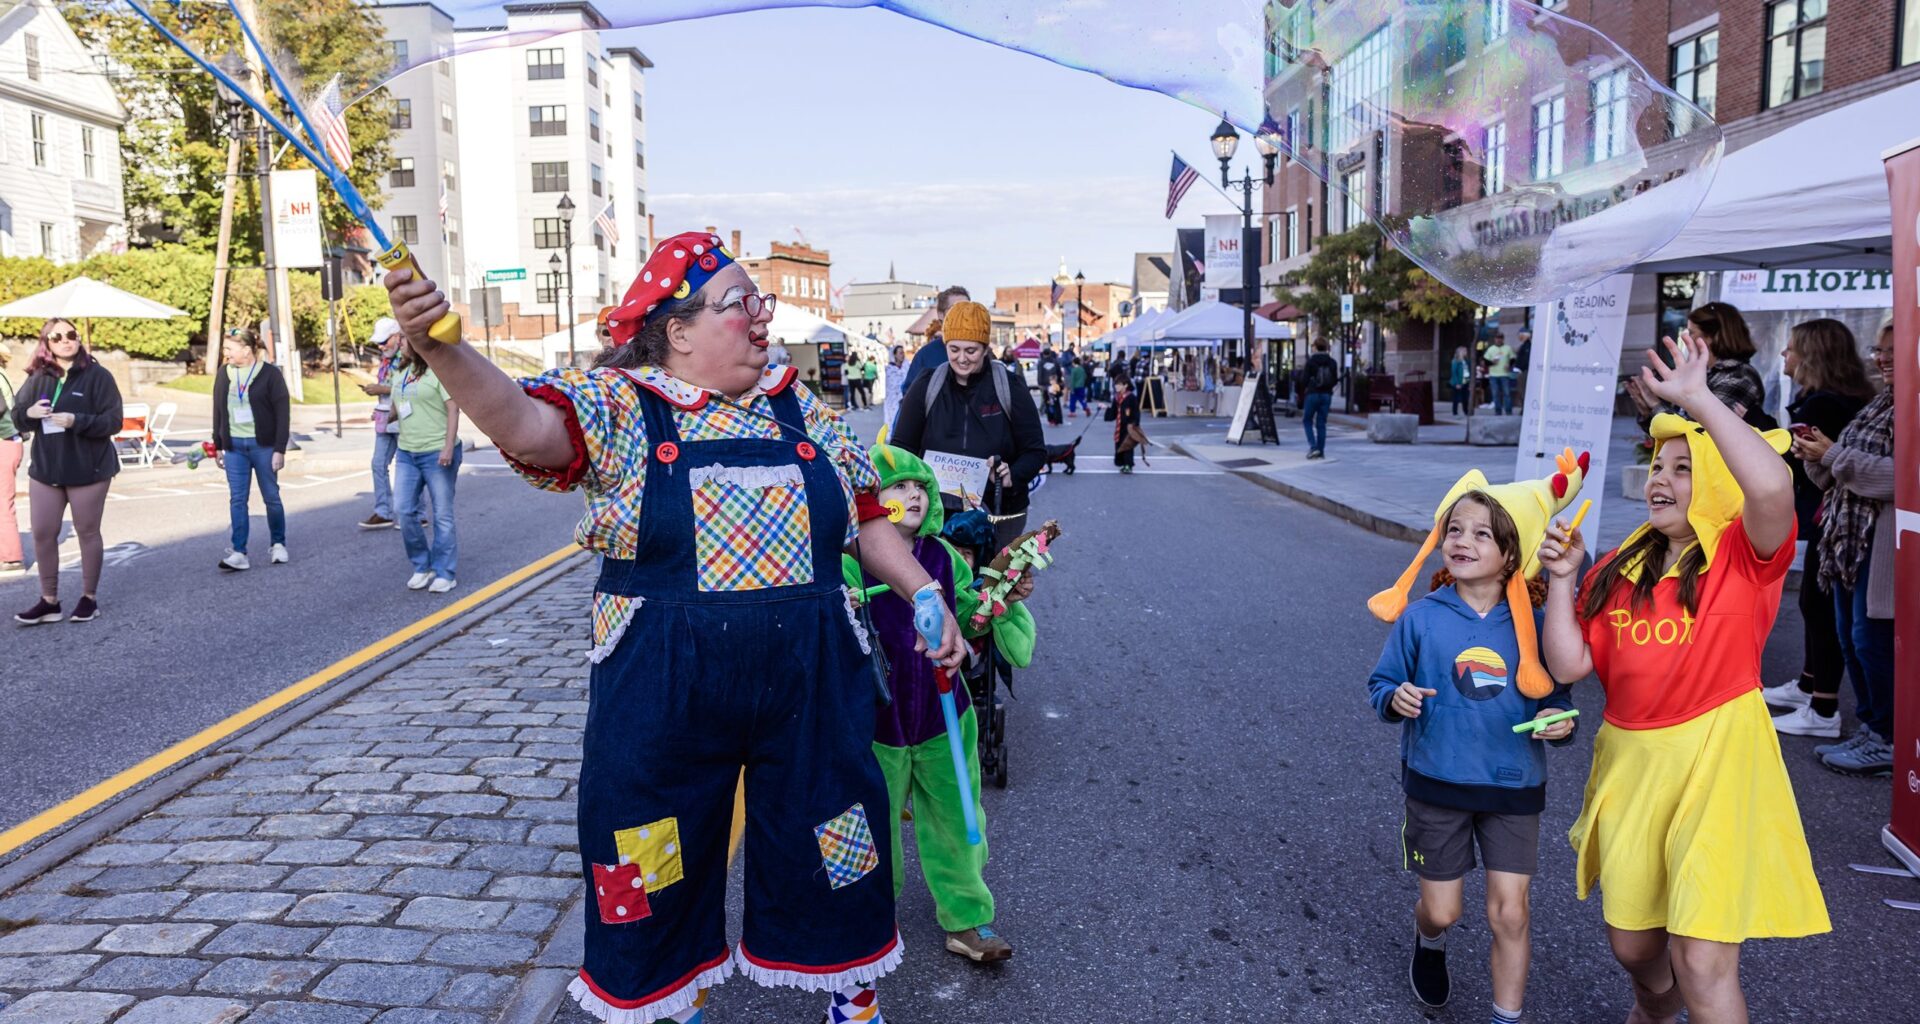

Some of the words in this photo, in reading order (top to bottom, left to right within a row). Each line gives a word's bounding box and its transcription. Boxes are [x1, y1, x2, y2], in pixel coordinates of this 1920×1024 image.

[290, 201, 311, 216] NH
[1218, 239, 1238, 251] NH
[487, 271, 518, 281] Thompson
[1740, 272, 1757, 281] NH
[1573, 294, 1616, 308] READING
[1586, 405, 1610, 415] create
[1570, 420, 1584, 430] that
[934, 455, 981, 470] DRAGONS
[941, 464, 968, 475] LOVE
